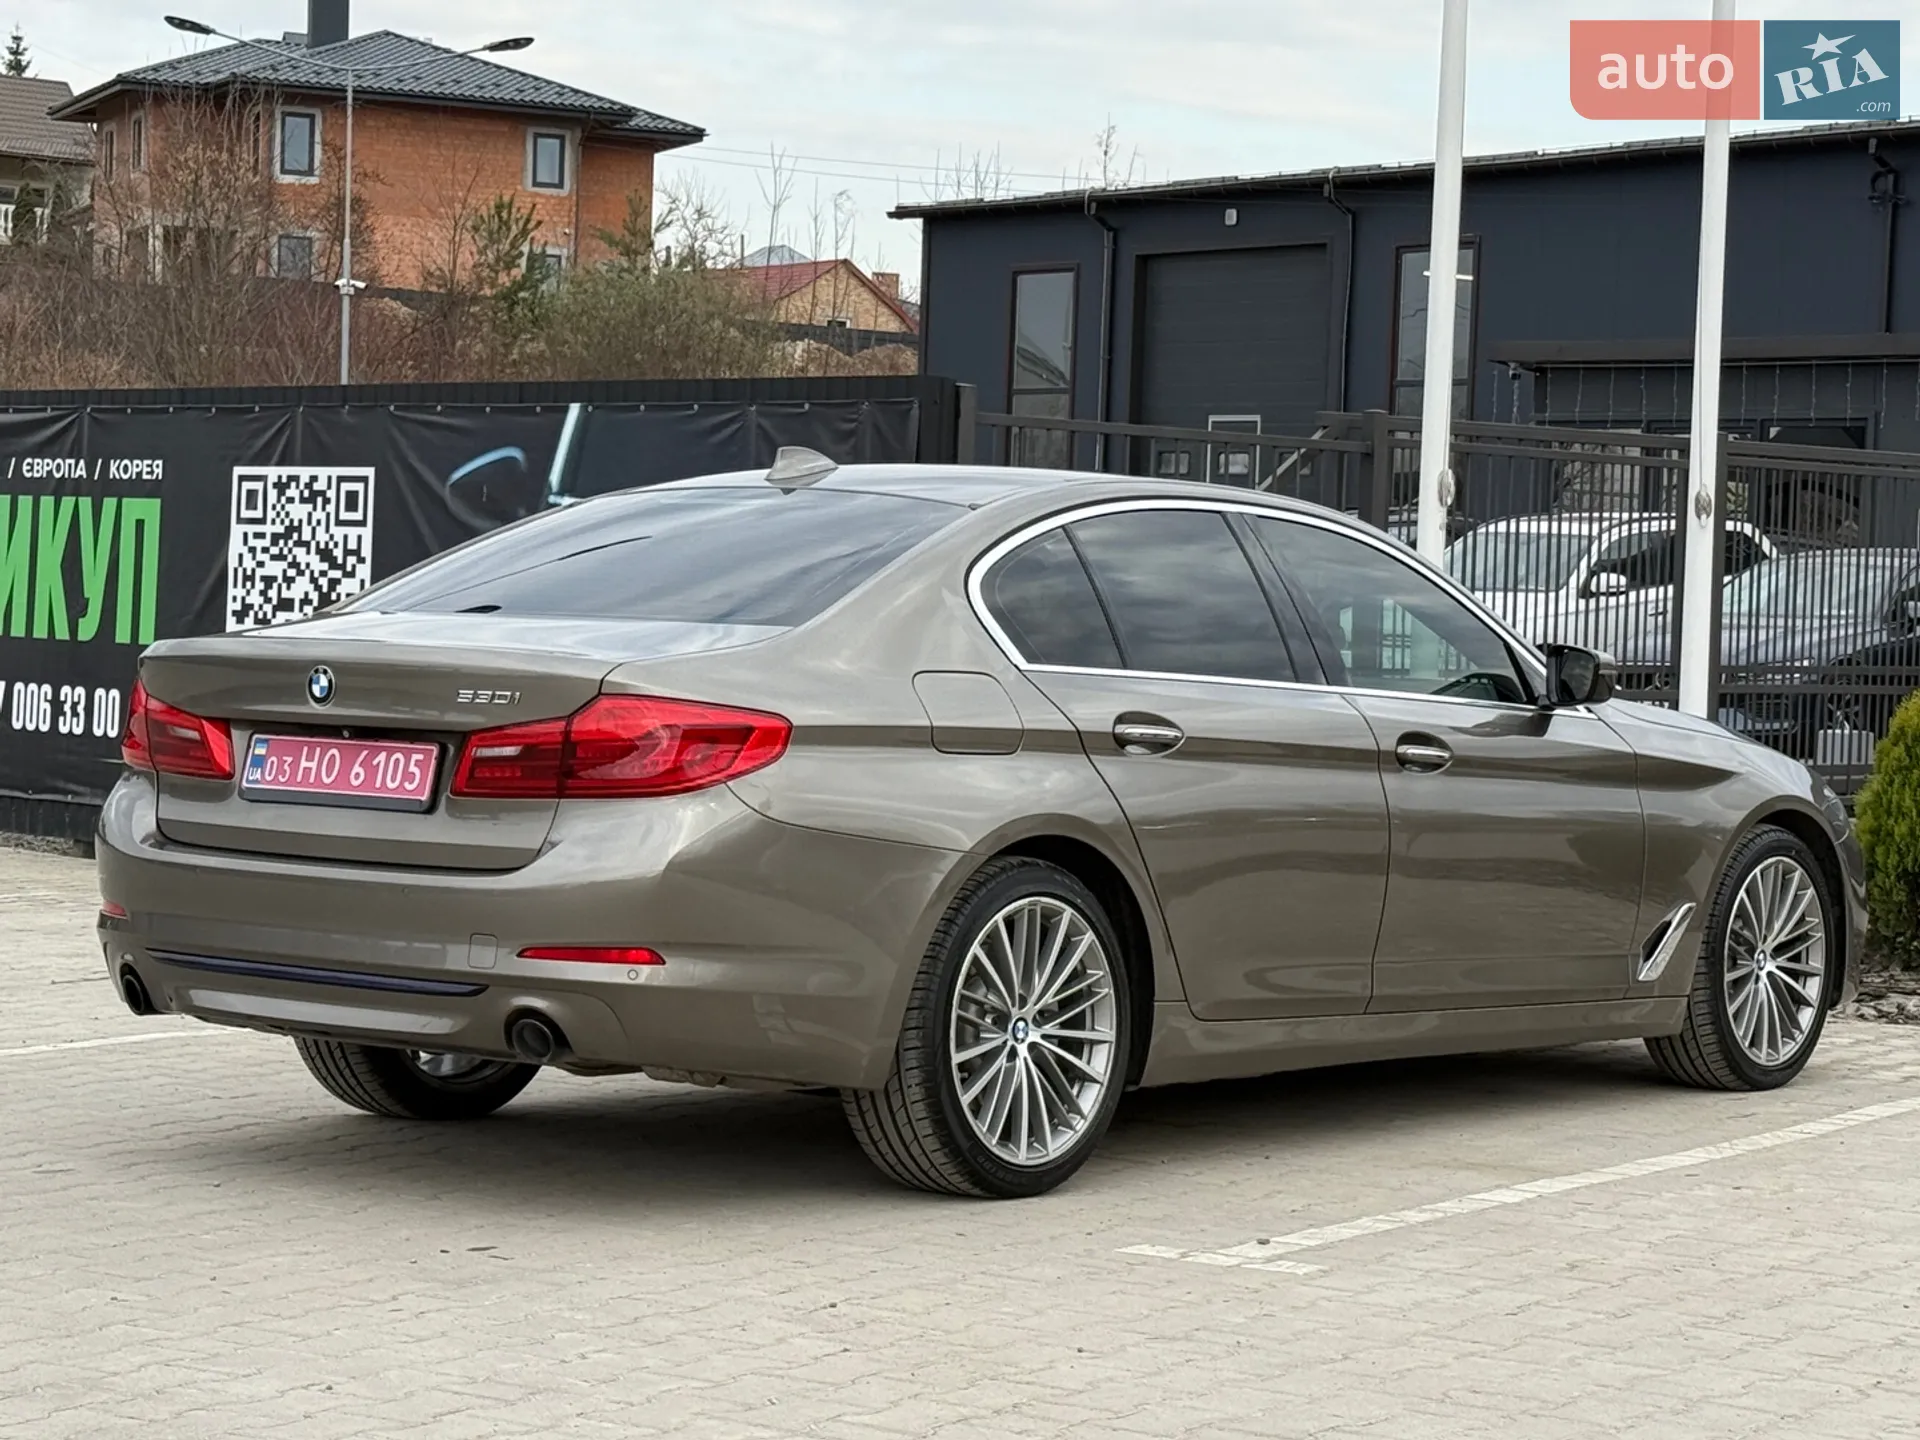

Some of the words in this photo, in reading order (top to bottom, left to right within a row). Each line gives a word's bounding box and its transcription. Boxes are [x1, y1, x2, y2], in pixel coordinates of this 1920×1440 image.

[22, 457, 87, 479] ЄВРОПА
[109, 459, 163, 480] КОРЕЯ
[456, 689, 521, 705] 530i
[11, 681, 53, 733] 006
[58, 685, 86, 735] 33
[92, 687, 120, 738] 00
[248, 766, 262, 781] UA
[349, 750, 425, 791] 6105
